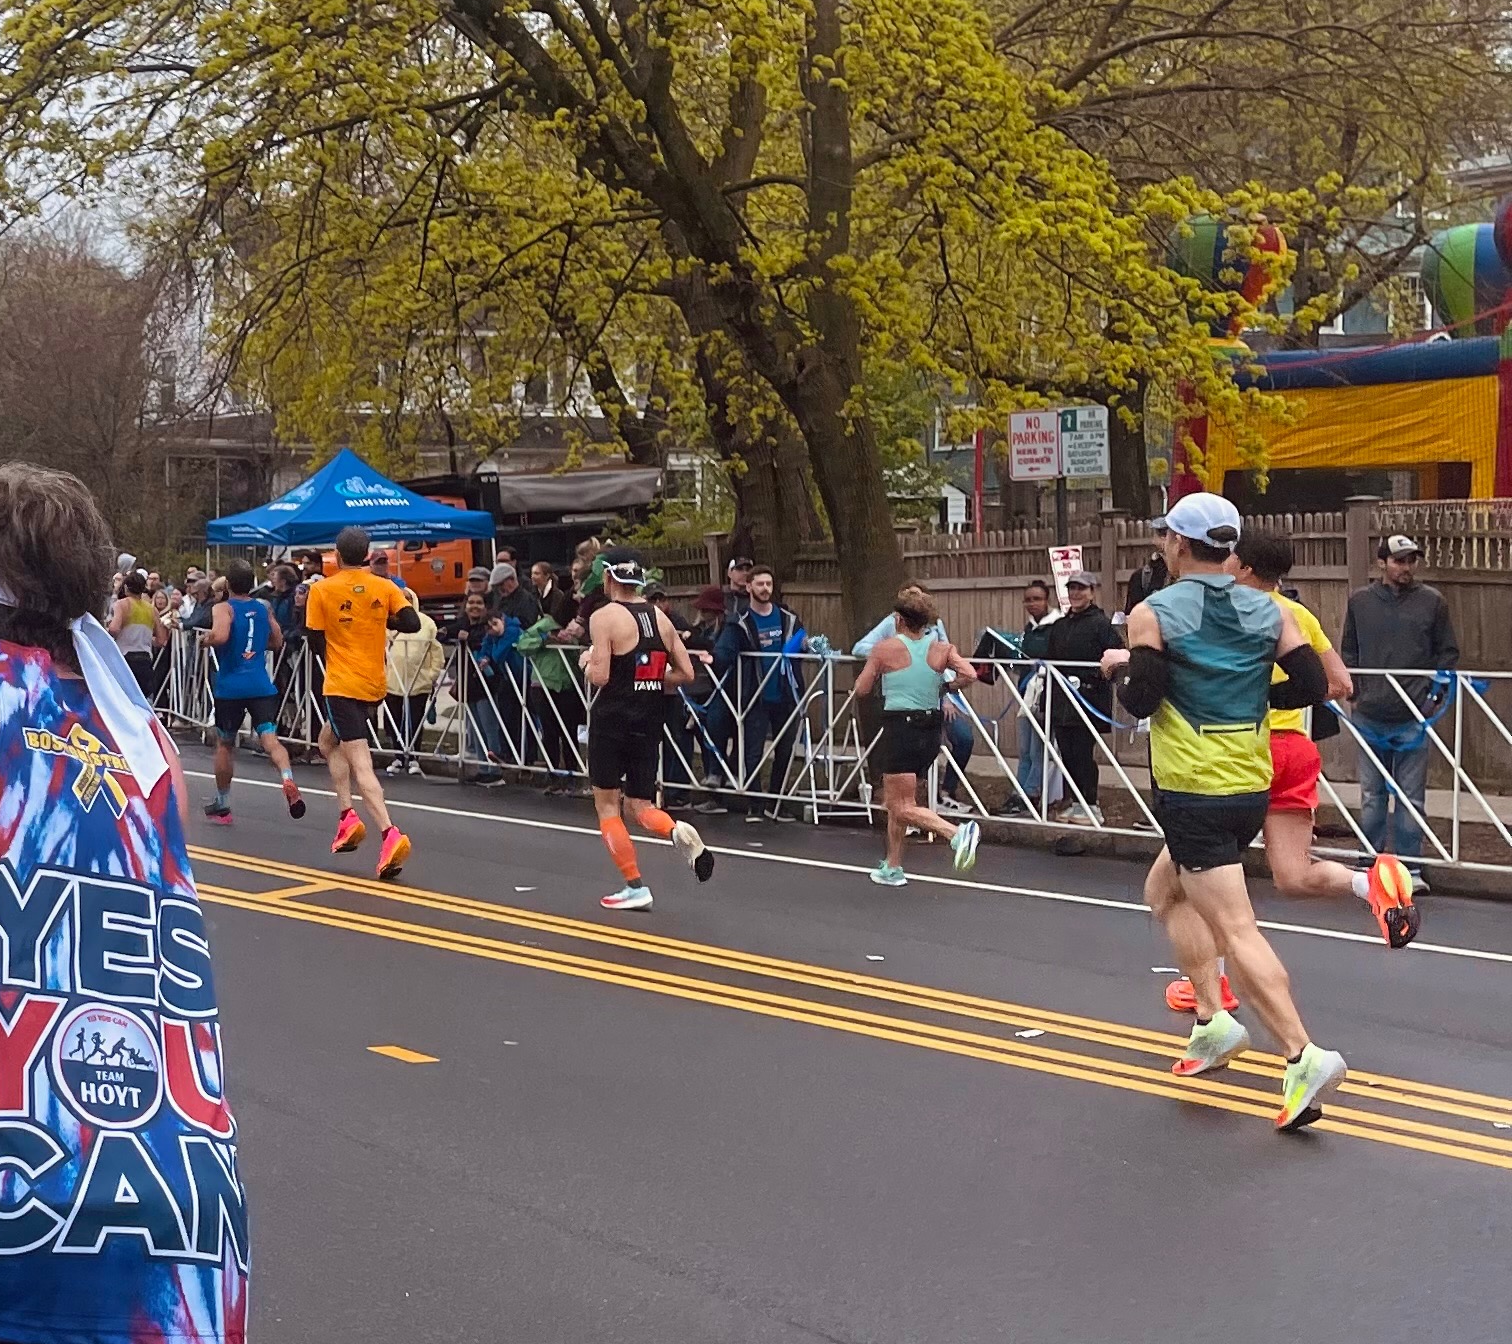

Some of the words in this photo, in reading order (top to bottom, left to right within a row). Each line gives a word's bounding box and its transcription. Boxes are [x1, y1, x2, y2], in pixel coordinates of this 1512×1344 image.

[1026, 417, 1041, 429] NO
[1013, 431, 1055, 445] PARKING
[1016, 447, 1038, 456] HERE
[1043, 447, 1054, 455] TO
[1017, 457, 1052, 465] CORNER
[26, 730, 92, 764] BOSTON
[112, 1017, 129, 1028] CAN
[95, 1070, 125, 1083] TEAM
[80, 1081, 142, 1109] HOYT
